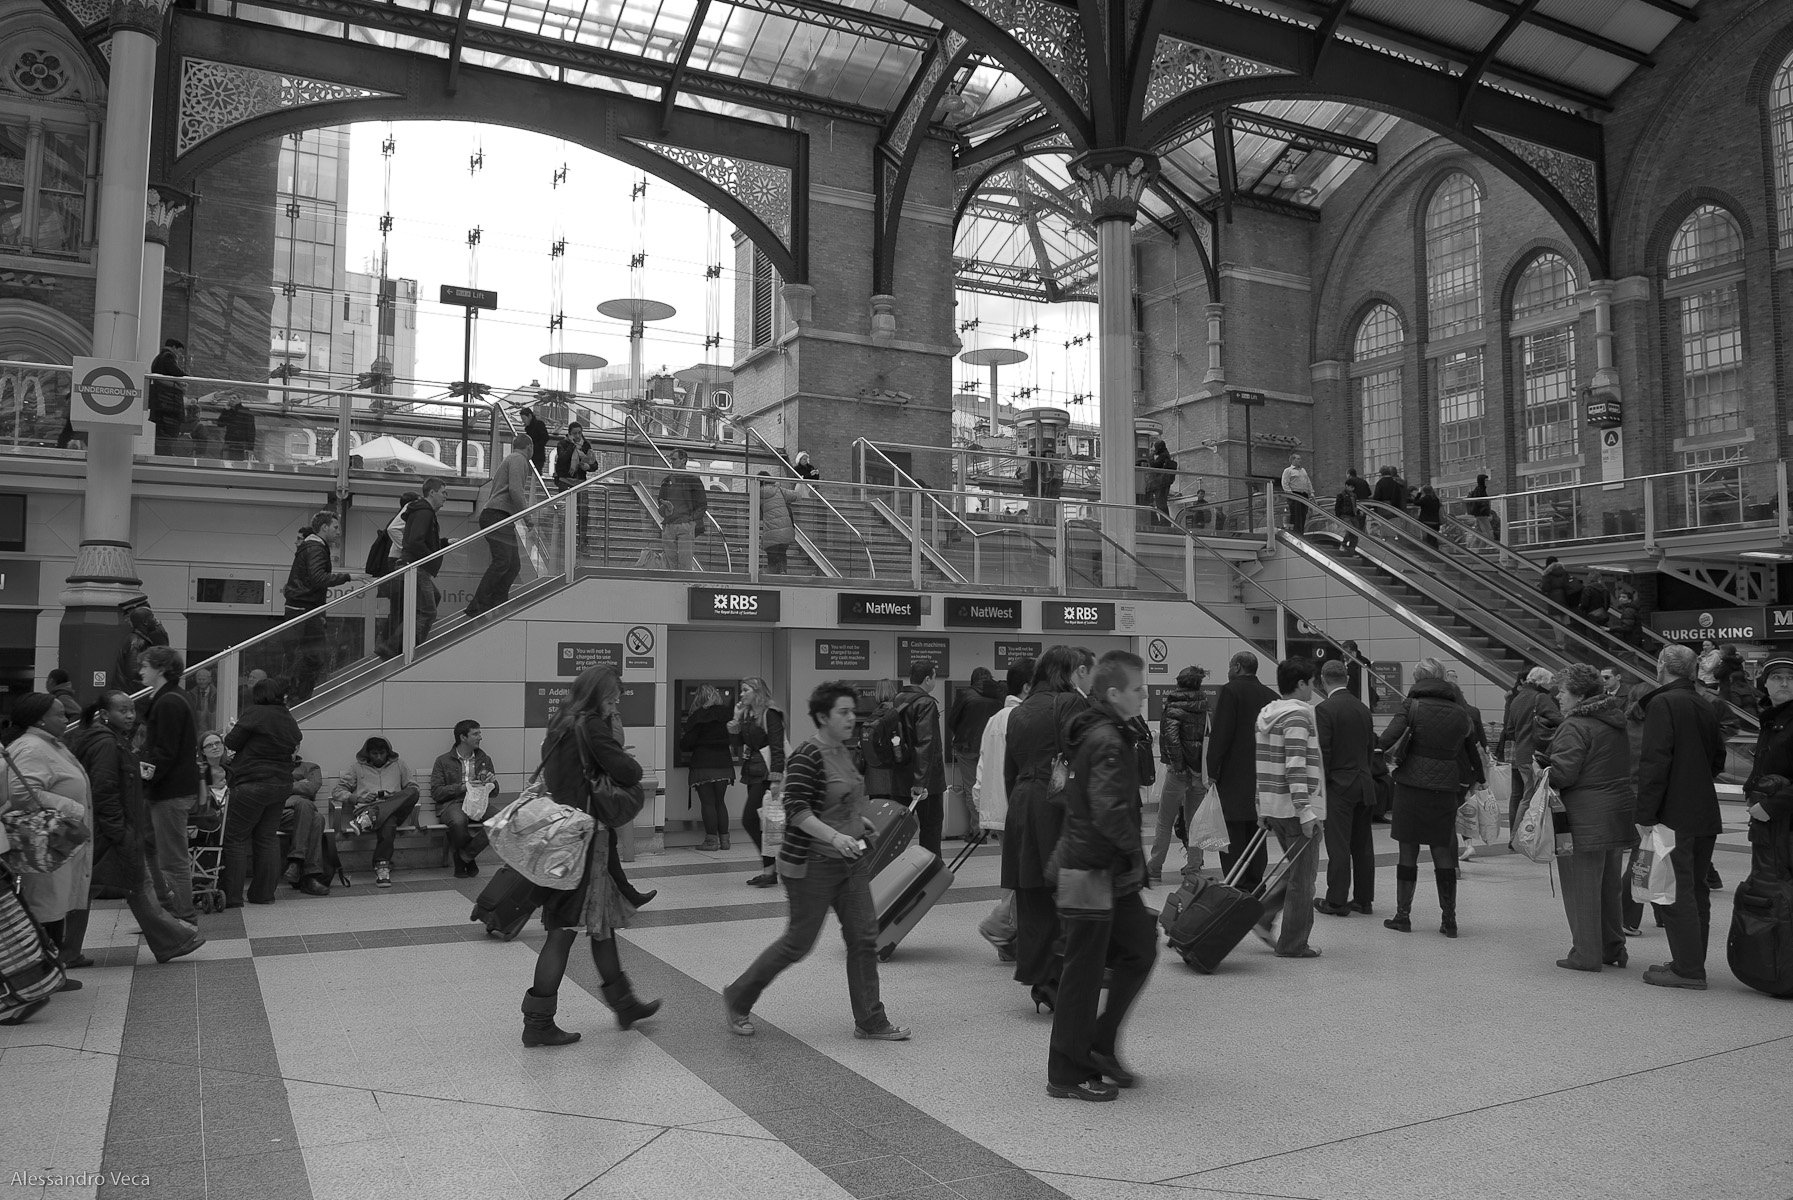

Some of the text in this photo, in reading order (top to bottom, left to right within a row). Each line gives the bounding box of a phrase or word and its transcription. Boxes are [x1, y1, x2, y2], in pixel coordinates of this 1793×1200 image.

[78, 385, 138, 397] UNDERGROUND
[1607, 433, 1617, 445] A
[730, 594, 758, 610] RBS
[865, 602, 912, 615] NatWest
[970, 606, 1013, 619] NatWest
[1076, 607, 1098, 620] RBS
[1662, 627, 1754, 640] BURGER KING
